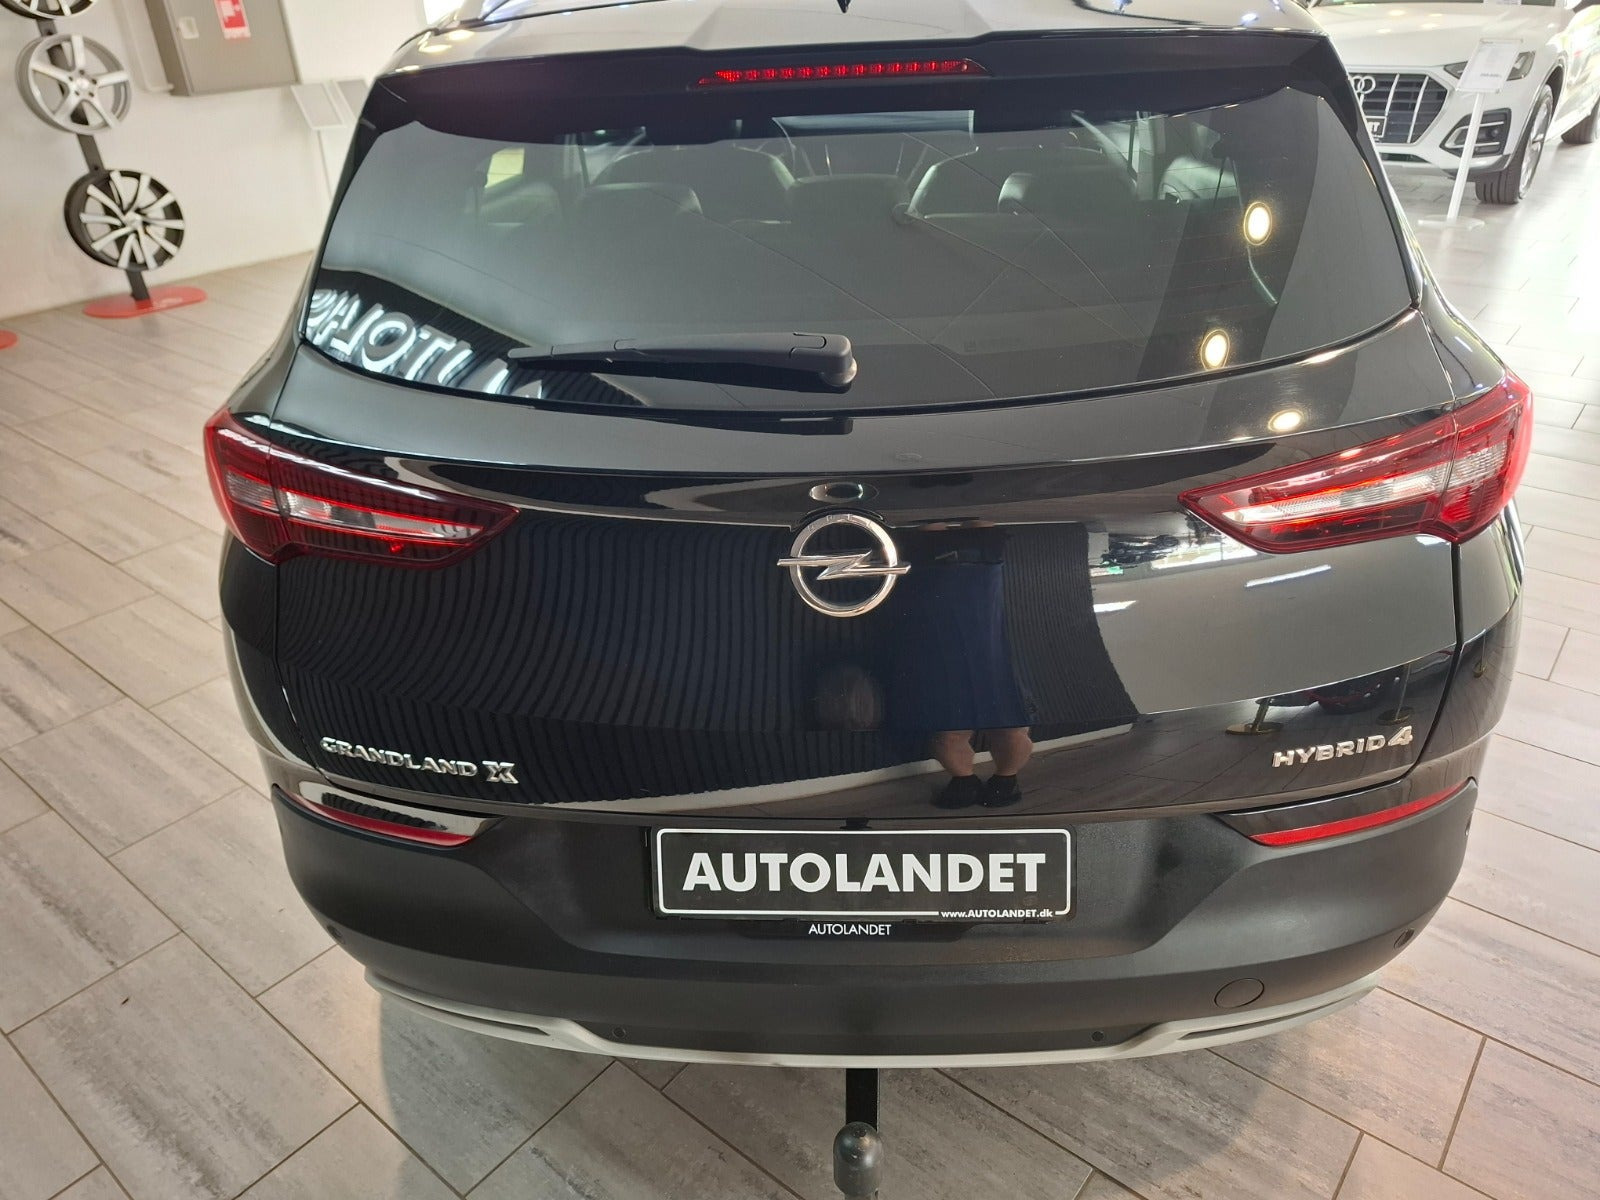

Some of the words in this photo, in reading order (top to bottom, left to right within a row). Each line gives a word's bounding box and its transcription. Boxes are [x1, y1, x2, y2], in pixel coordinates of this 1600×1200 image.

[320, 736, 478, 777] GRANDLAND
[482, 760, 519, 784] X
[682, 852, 1046, 893] AUTOLANDET
[941, 908, 1053, 919] www.AUTOLANDET.dk
[808, 923, 892, 936] AUTOLANDET
